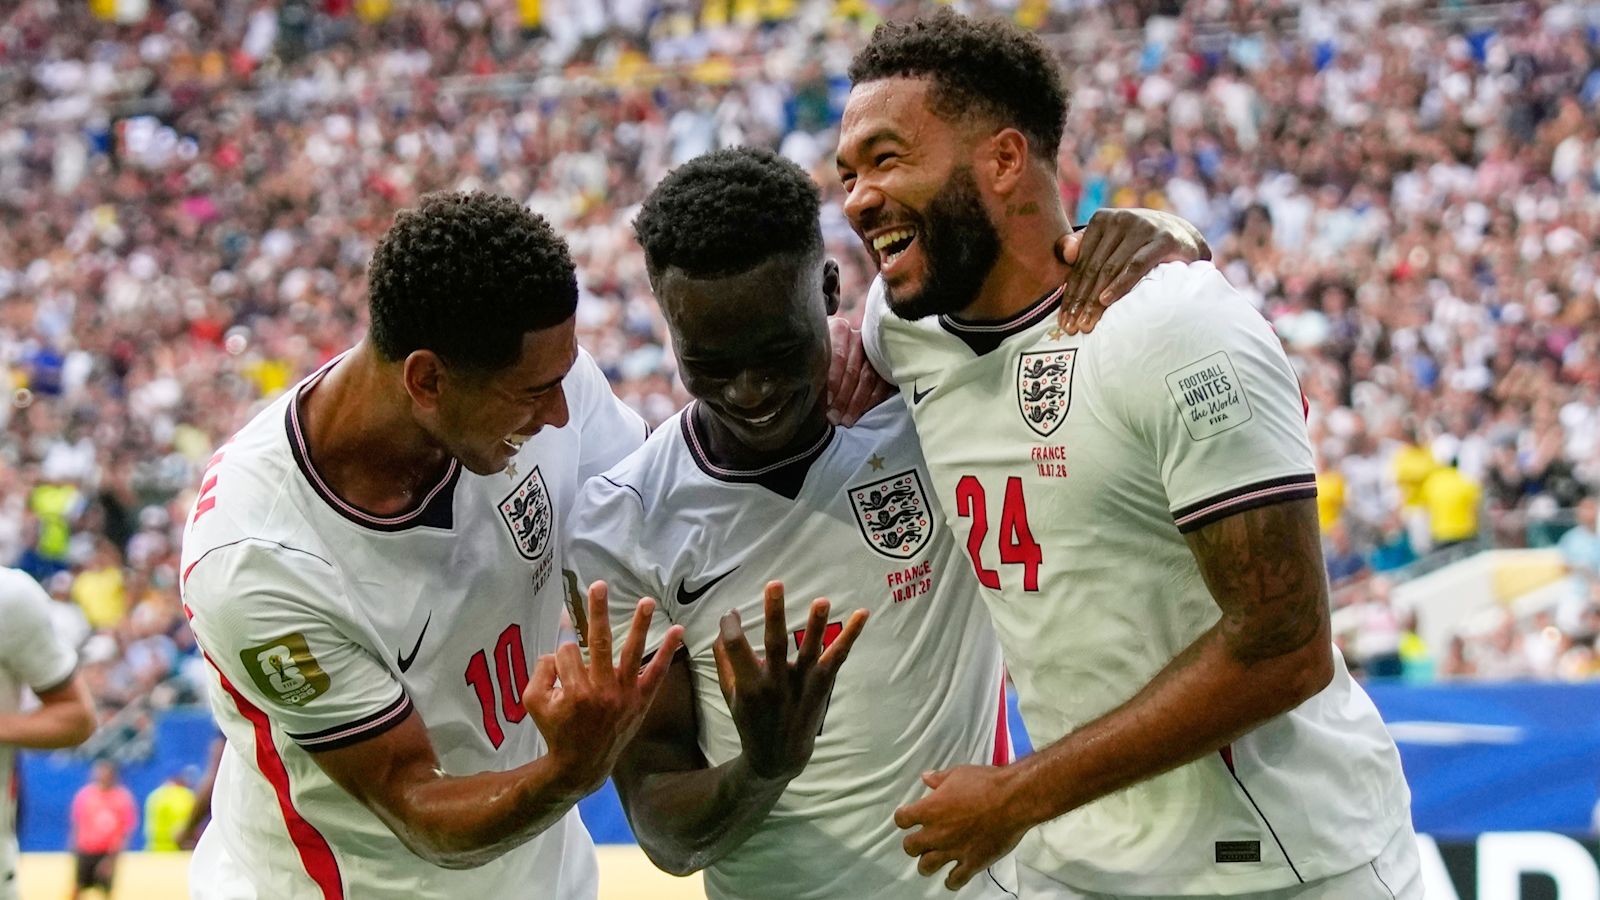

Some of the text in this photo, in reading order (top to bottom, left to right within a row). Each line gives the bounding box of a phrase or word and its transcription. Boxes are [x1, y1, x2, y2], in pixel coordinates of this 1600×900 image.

[1178, 363, 1225, 391] FOOTBALL
[1183, 375, 1232, 407] UNITES
[1190, 390, 1240, 422] the World
[1209, 413, 1229, 425] FIFA
[1031, 446, 1066, 461] FRANCE
[955, 475, 1043, 592] 24
[887, 560, 932, 588] FRANCE
[464, 623, 530, 750] 10
